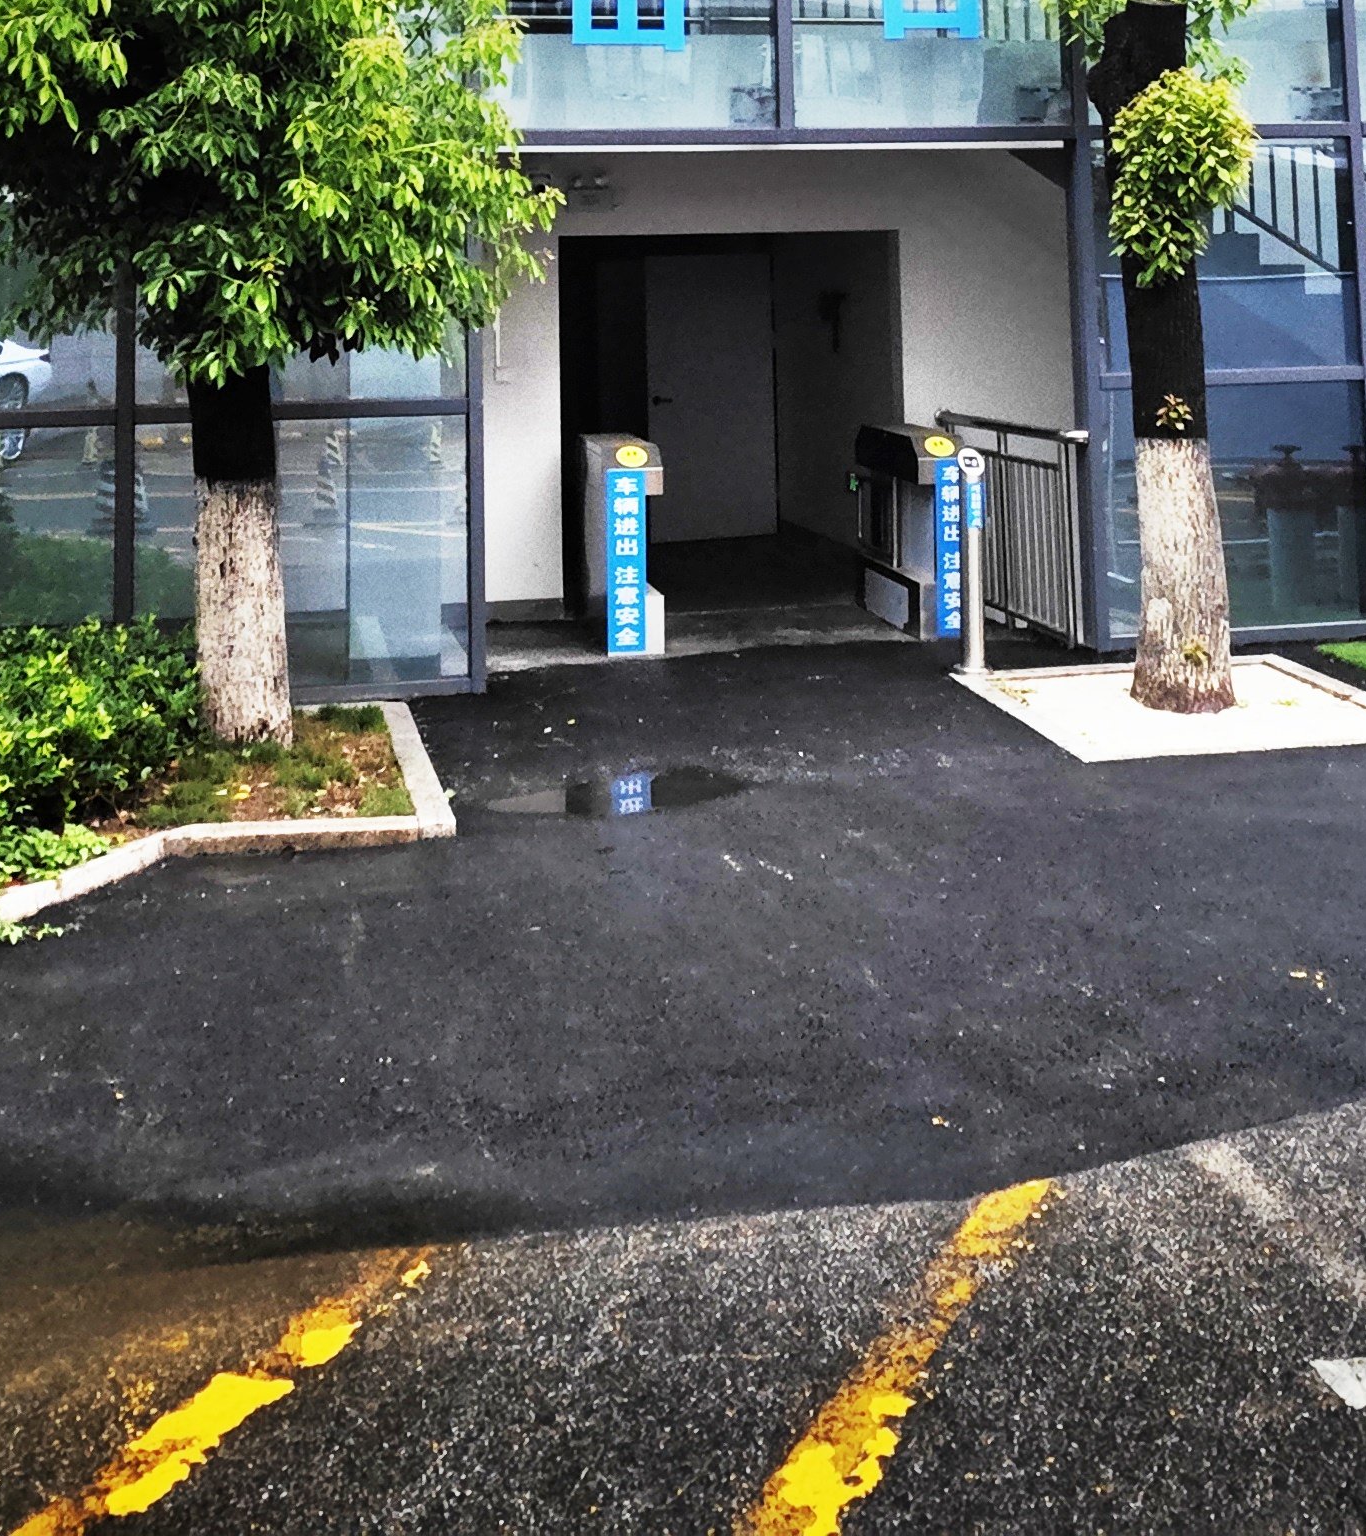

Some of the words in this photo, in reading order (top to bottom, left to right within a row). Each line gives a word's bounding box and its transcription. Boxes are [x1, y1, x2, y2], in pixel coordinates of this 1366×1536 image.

[613, 476, 640, 557] 车辆进出
[614, 565, 641, 647] 注意安全
